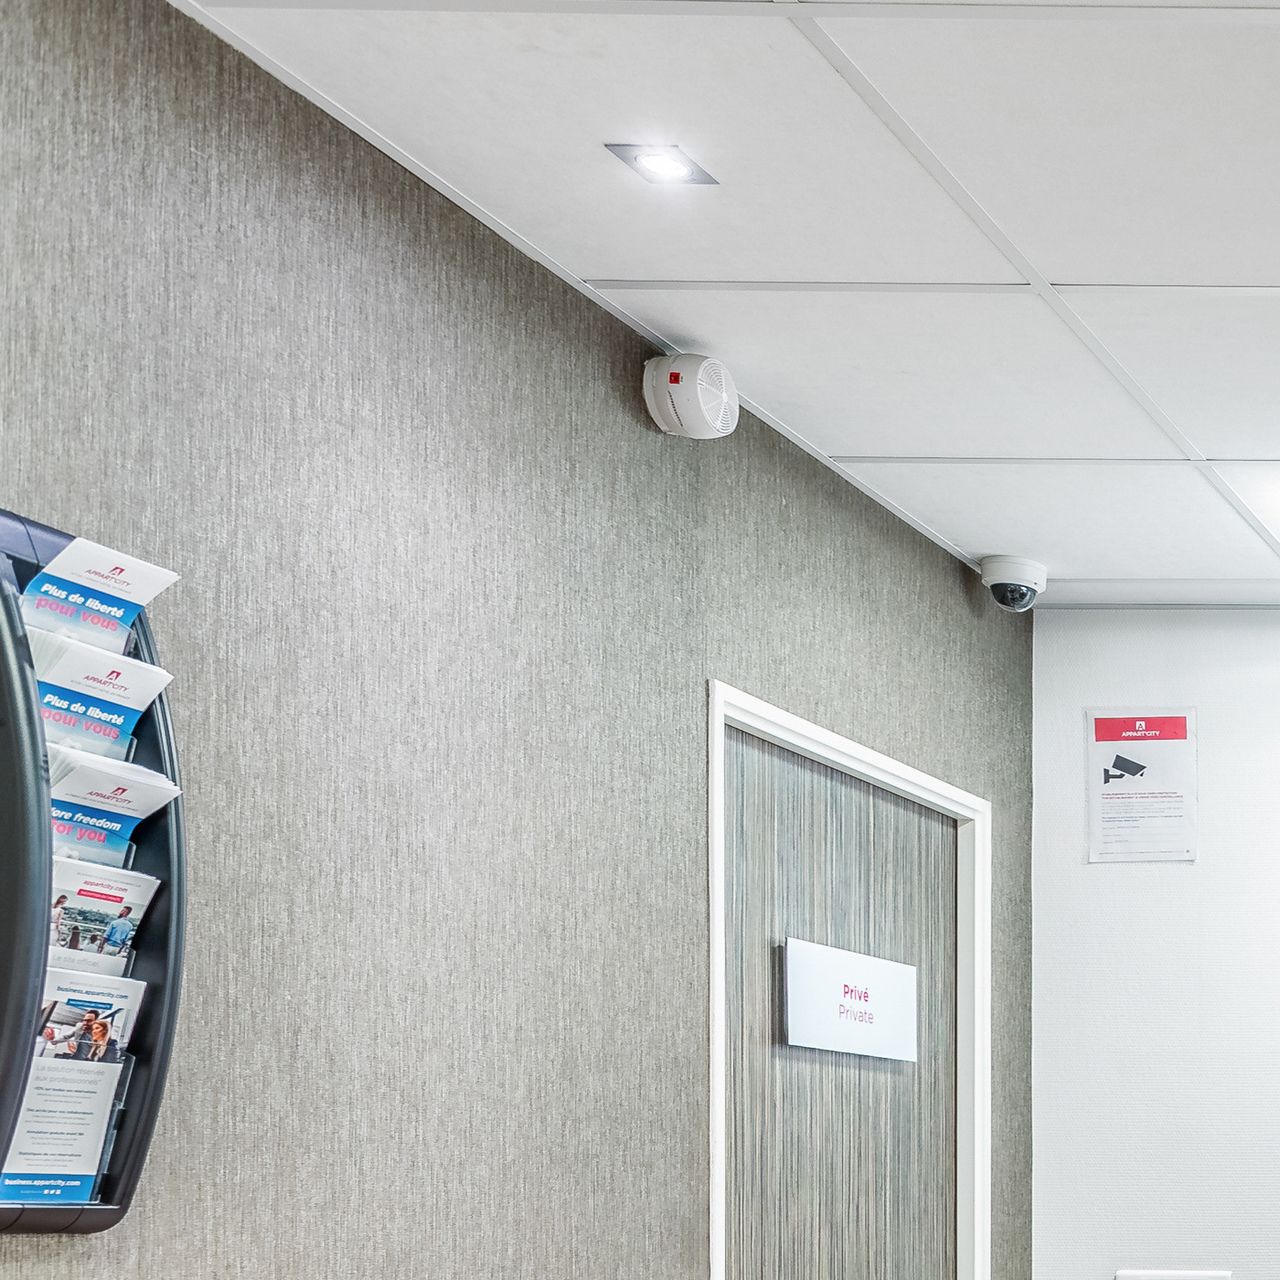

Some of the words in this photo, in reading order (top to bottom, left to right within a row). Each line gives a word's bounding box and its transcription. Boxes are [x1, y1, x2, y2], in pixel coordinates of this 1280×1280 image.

[41, 583, 68, 599] Plus
[68, 594, 85, 604] de
[85, 598, 125, 618] liberté
[35, 596, 77, 617] pour
[81, 611, 118, 631] vous
[43, 693, 69, 709] Plus
[70, 703, 85, 714] de
[86, 707, 125, 725] liberté
[83, 720, 119, 740] vous
[51, 807, 72, 820] ore
[73, 813, 122, 831] freedom
[76, 828, 107, 843] you
[843, 983, 869, 1002] Privé
[838, 1004, 874, 1024] Private
